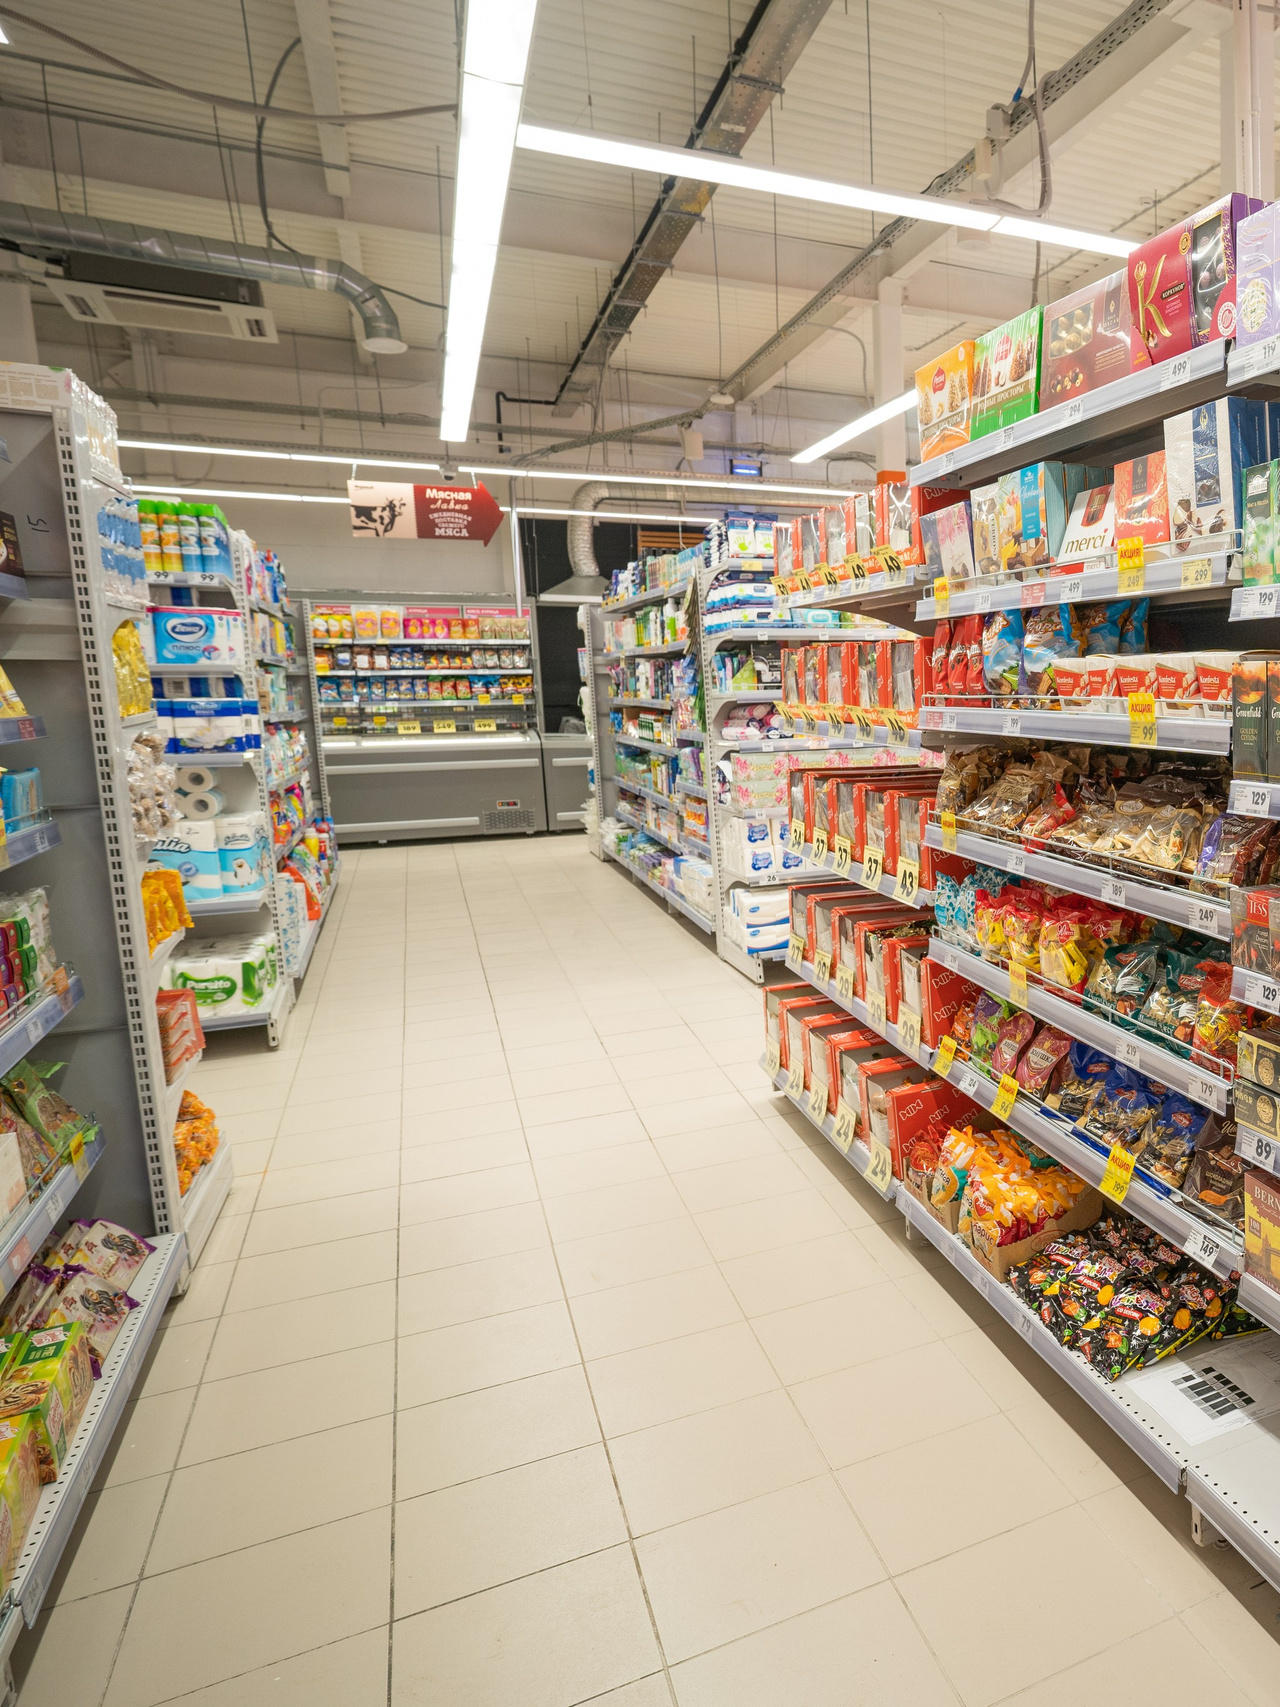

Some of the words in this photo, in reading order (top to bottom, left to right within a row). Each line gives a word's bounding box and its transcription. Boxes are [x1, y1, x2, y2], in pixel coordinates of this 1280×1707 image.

[1171, 361, 1187, 376] 499
[425, 487, 473, 501] Мясная
[434, 528, 469, 538] МЯСА
[1064, 533, 1108, 554] merci
[1119, 547, 1142, 560] АКЦИЯ!
[1194, 569, 1208, 581] 299
[1067, 581, 1080, 594] 499
[1130, 702, 1153, 715] АКЦИЯ!
[1142, 727, 1154, 740] 99
[837, 847, 848, 869] 37
[866, 858, 879, 882] 37
[900, 869, 914, 895] 43
[1198, 909, 1214, 923] 249
[1200, 1082, 1213, 1096] 179
[836, 1118, 851, 1144] 24
[1255, 1138, 1272, 1157] 89
[874, 1145, 888, 1172] 24
